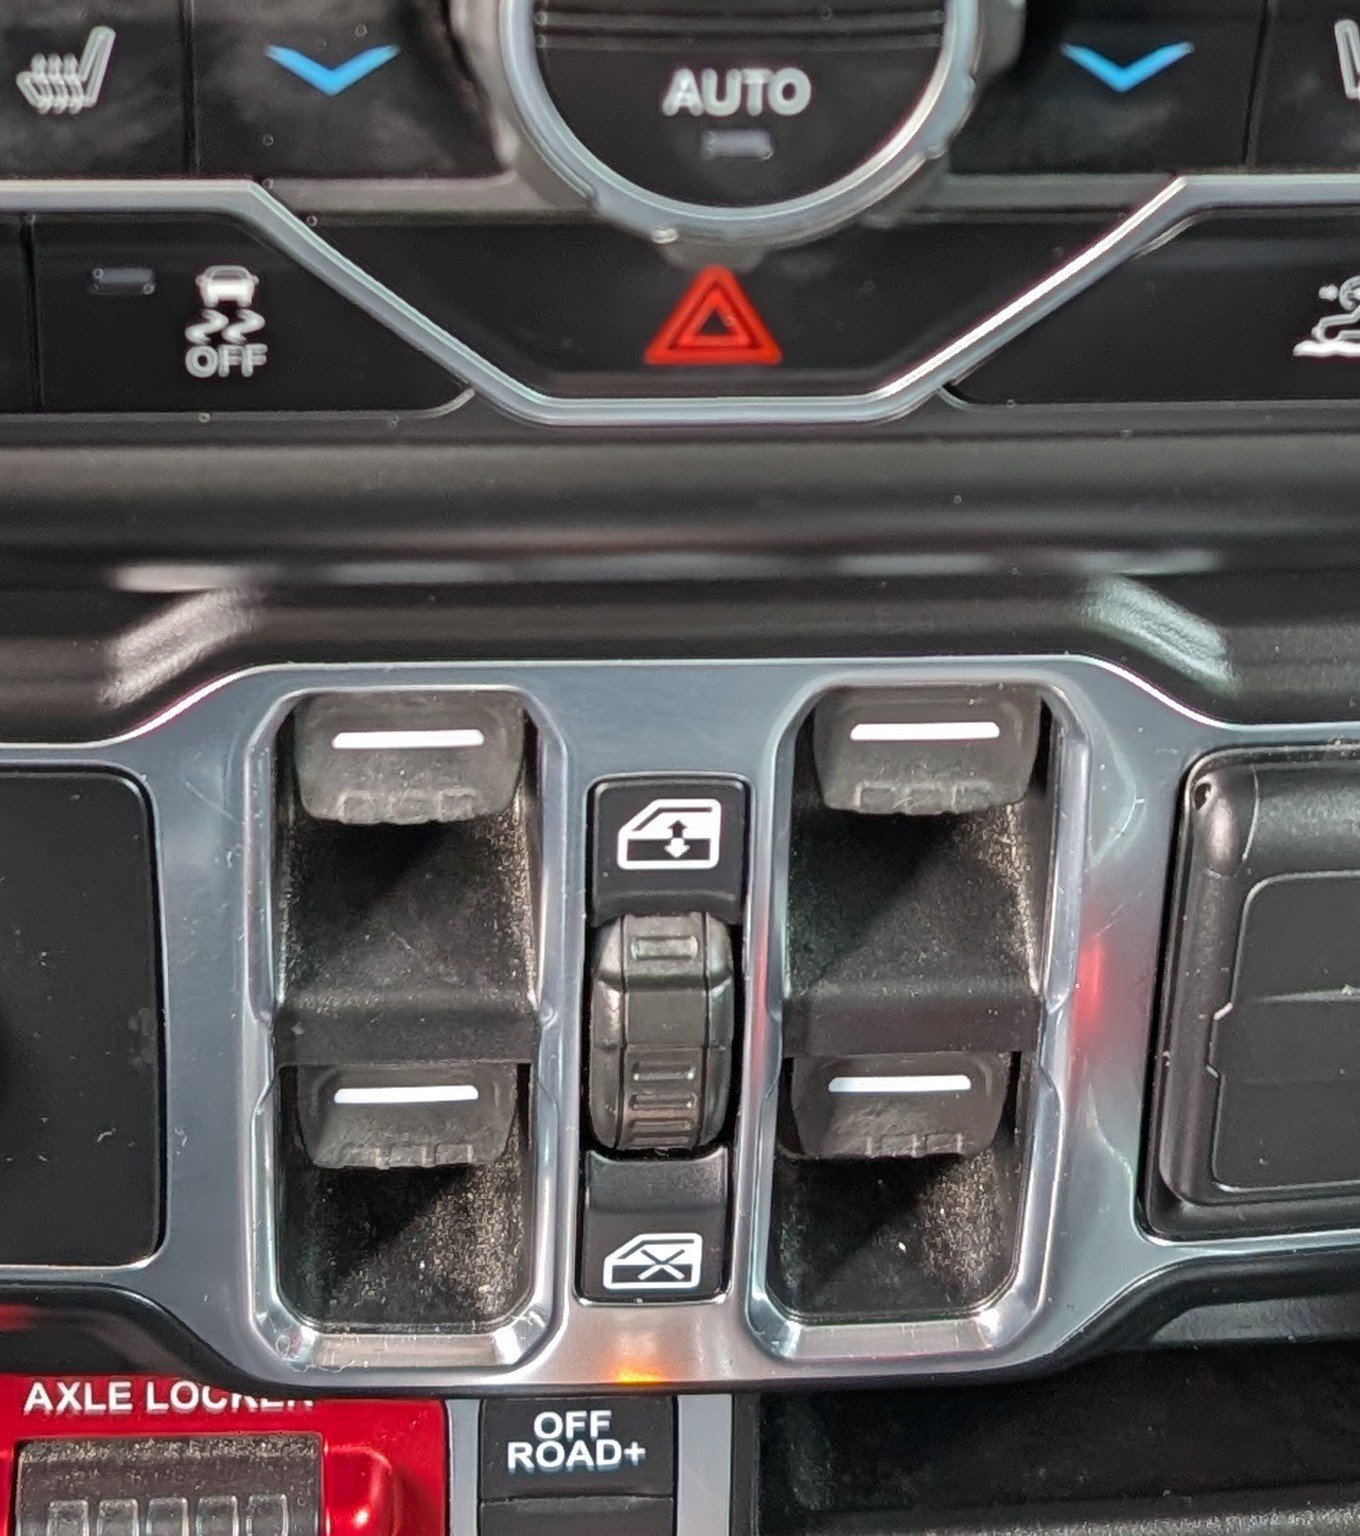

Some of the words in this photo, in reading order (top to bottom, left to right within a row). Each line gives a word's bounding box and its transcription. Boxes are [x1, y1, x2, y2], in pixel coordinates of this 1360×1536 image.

[661, 67, 812, 117] AUTO
[184, 343, 268, 379] OFF
[23, 1380, 134, 1412] AXLE
[533, 1409, 612, 1440] OFF
[506, 1438, 646, 1474] ROAD+
